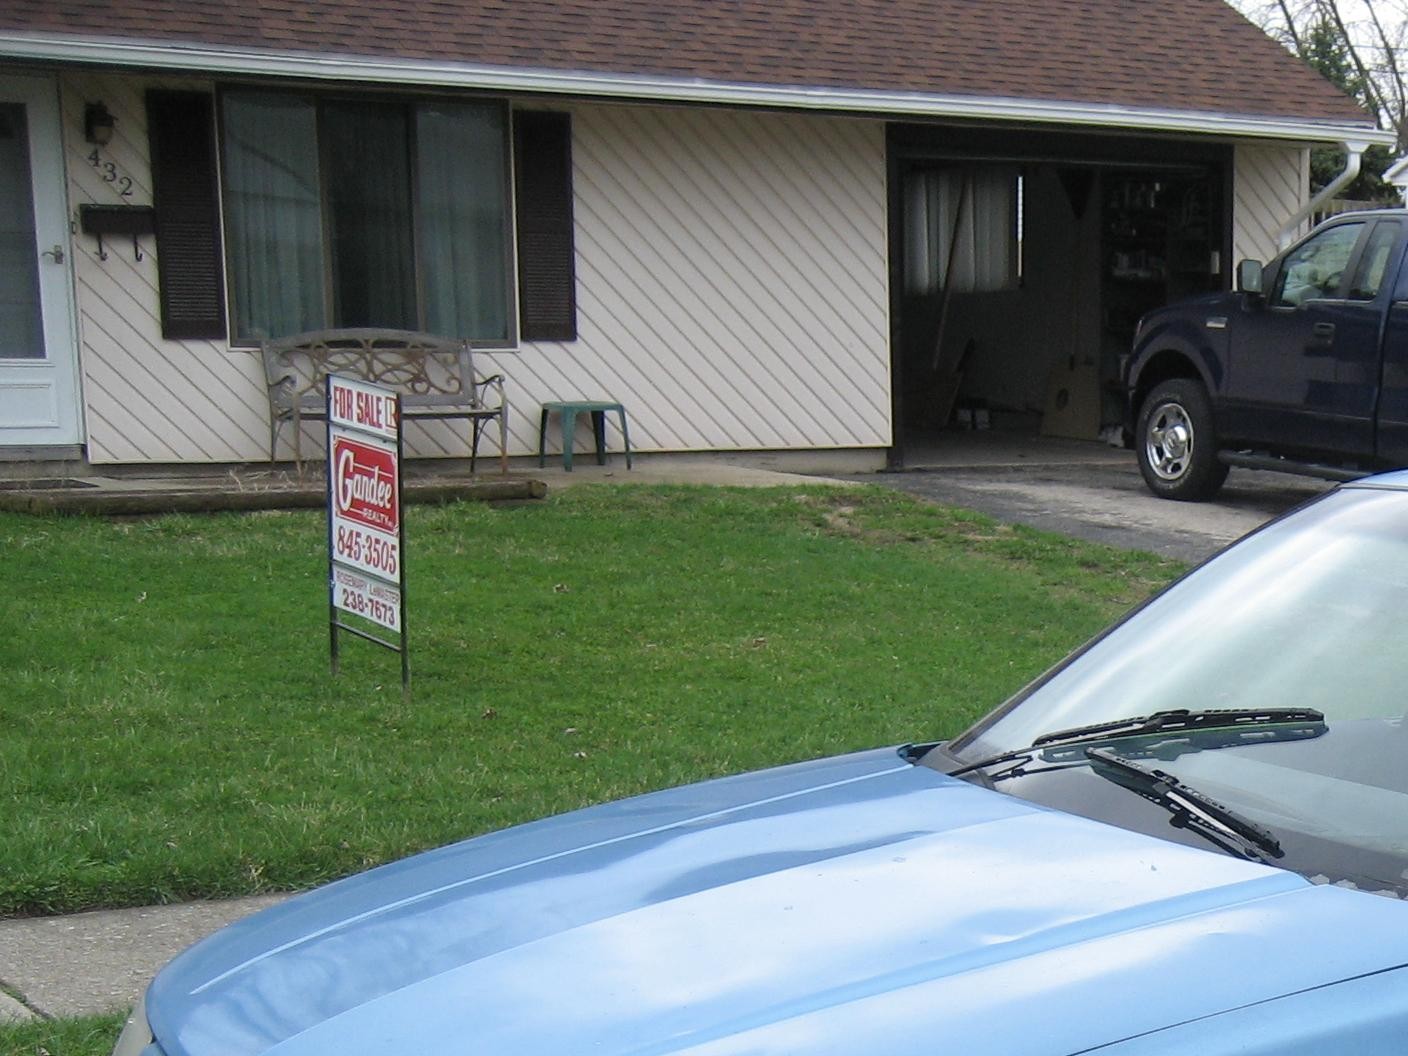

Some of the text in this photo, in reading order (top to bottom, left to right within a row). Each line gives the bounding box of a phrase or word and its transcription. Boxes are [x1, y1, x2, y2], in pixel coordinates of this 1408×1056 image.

[88, 149, 133, 196] 432
[334, 385, 353, 421] FOR
[356, 391, 382, 429] SALE
[338, 448, 392, 511] Gandee
[337, 525, 397, 576] 845-3505
